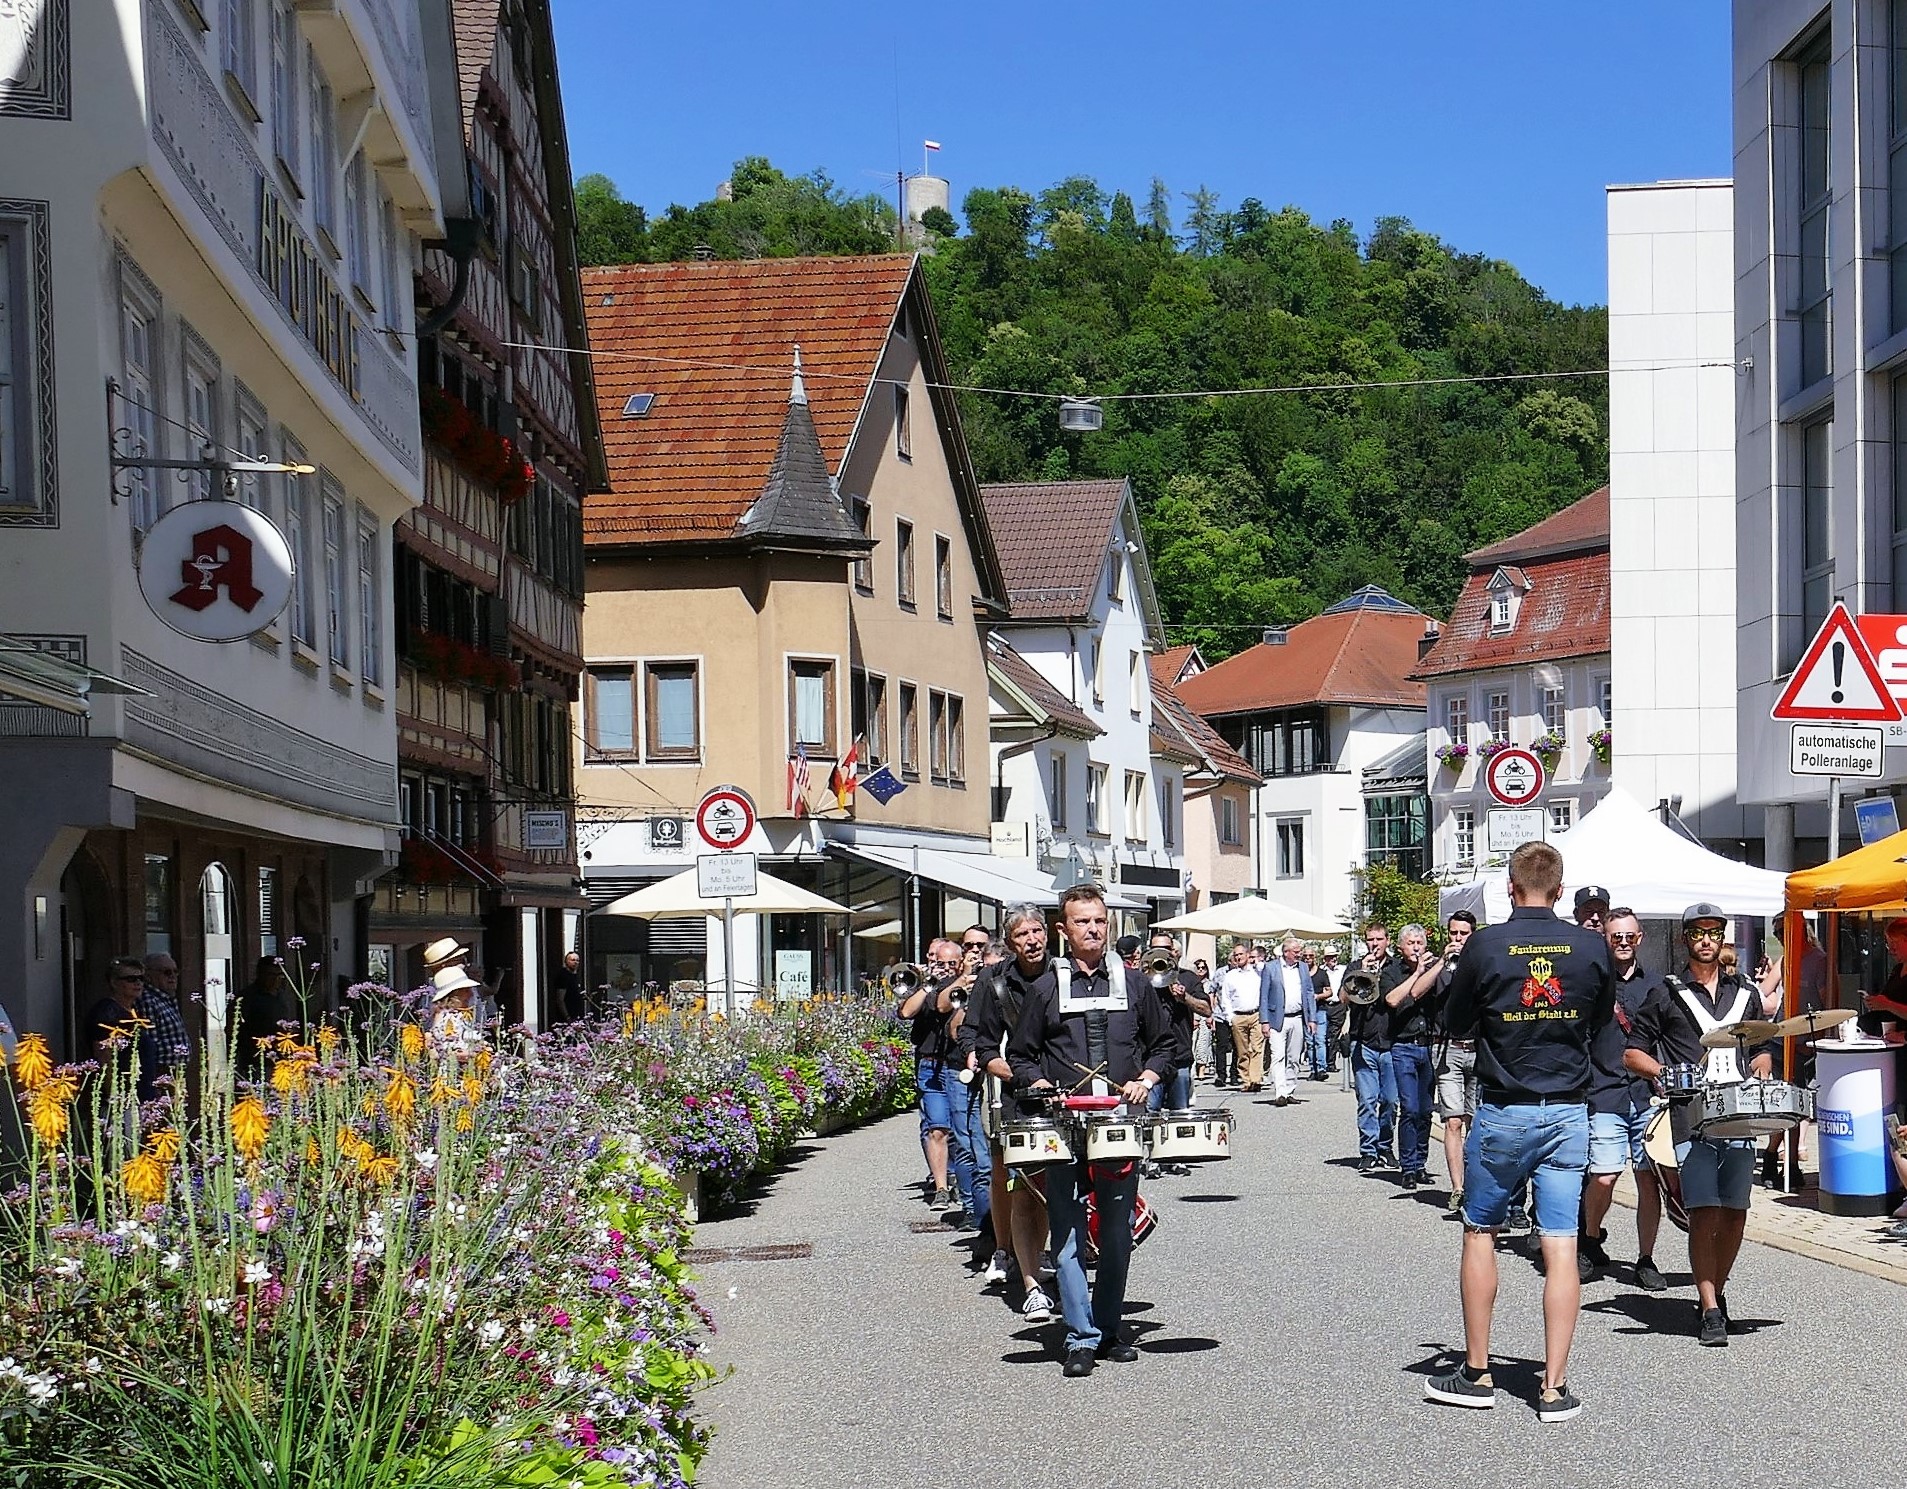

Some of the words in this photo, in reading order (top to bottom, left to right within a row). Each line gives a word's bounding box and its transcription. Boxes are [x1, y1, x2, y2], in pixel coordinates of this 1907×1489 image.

[260, 177, 361, 405] APOTHEKE
[1798, 735, 1876, 749] automatische
[1801, 753, 1873, 771] Polleranlage
[723, 884, 754, 893] Feiertagen
[780, 970, 808, 982] Café
[1502, 1011, 1522, 1022] Weil
[1523, 1011, 1537, 1021] der
[1538, 1009, 1562, 1019] Stadt
[1827, 1121, 1852, 1136] SIND.
